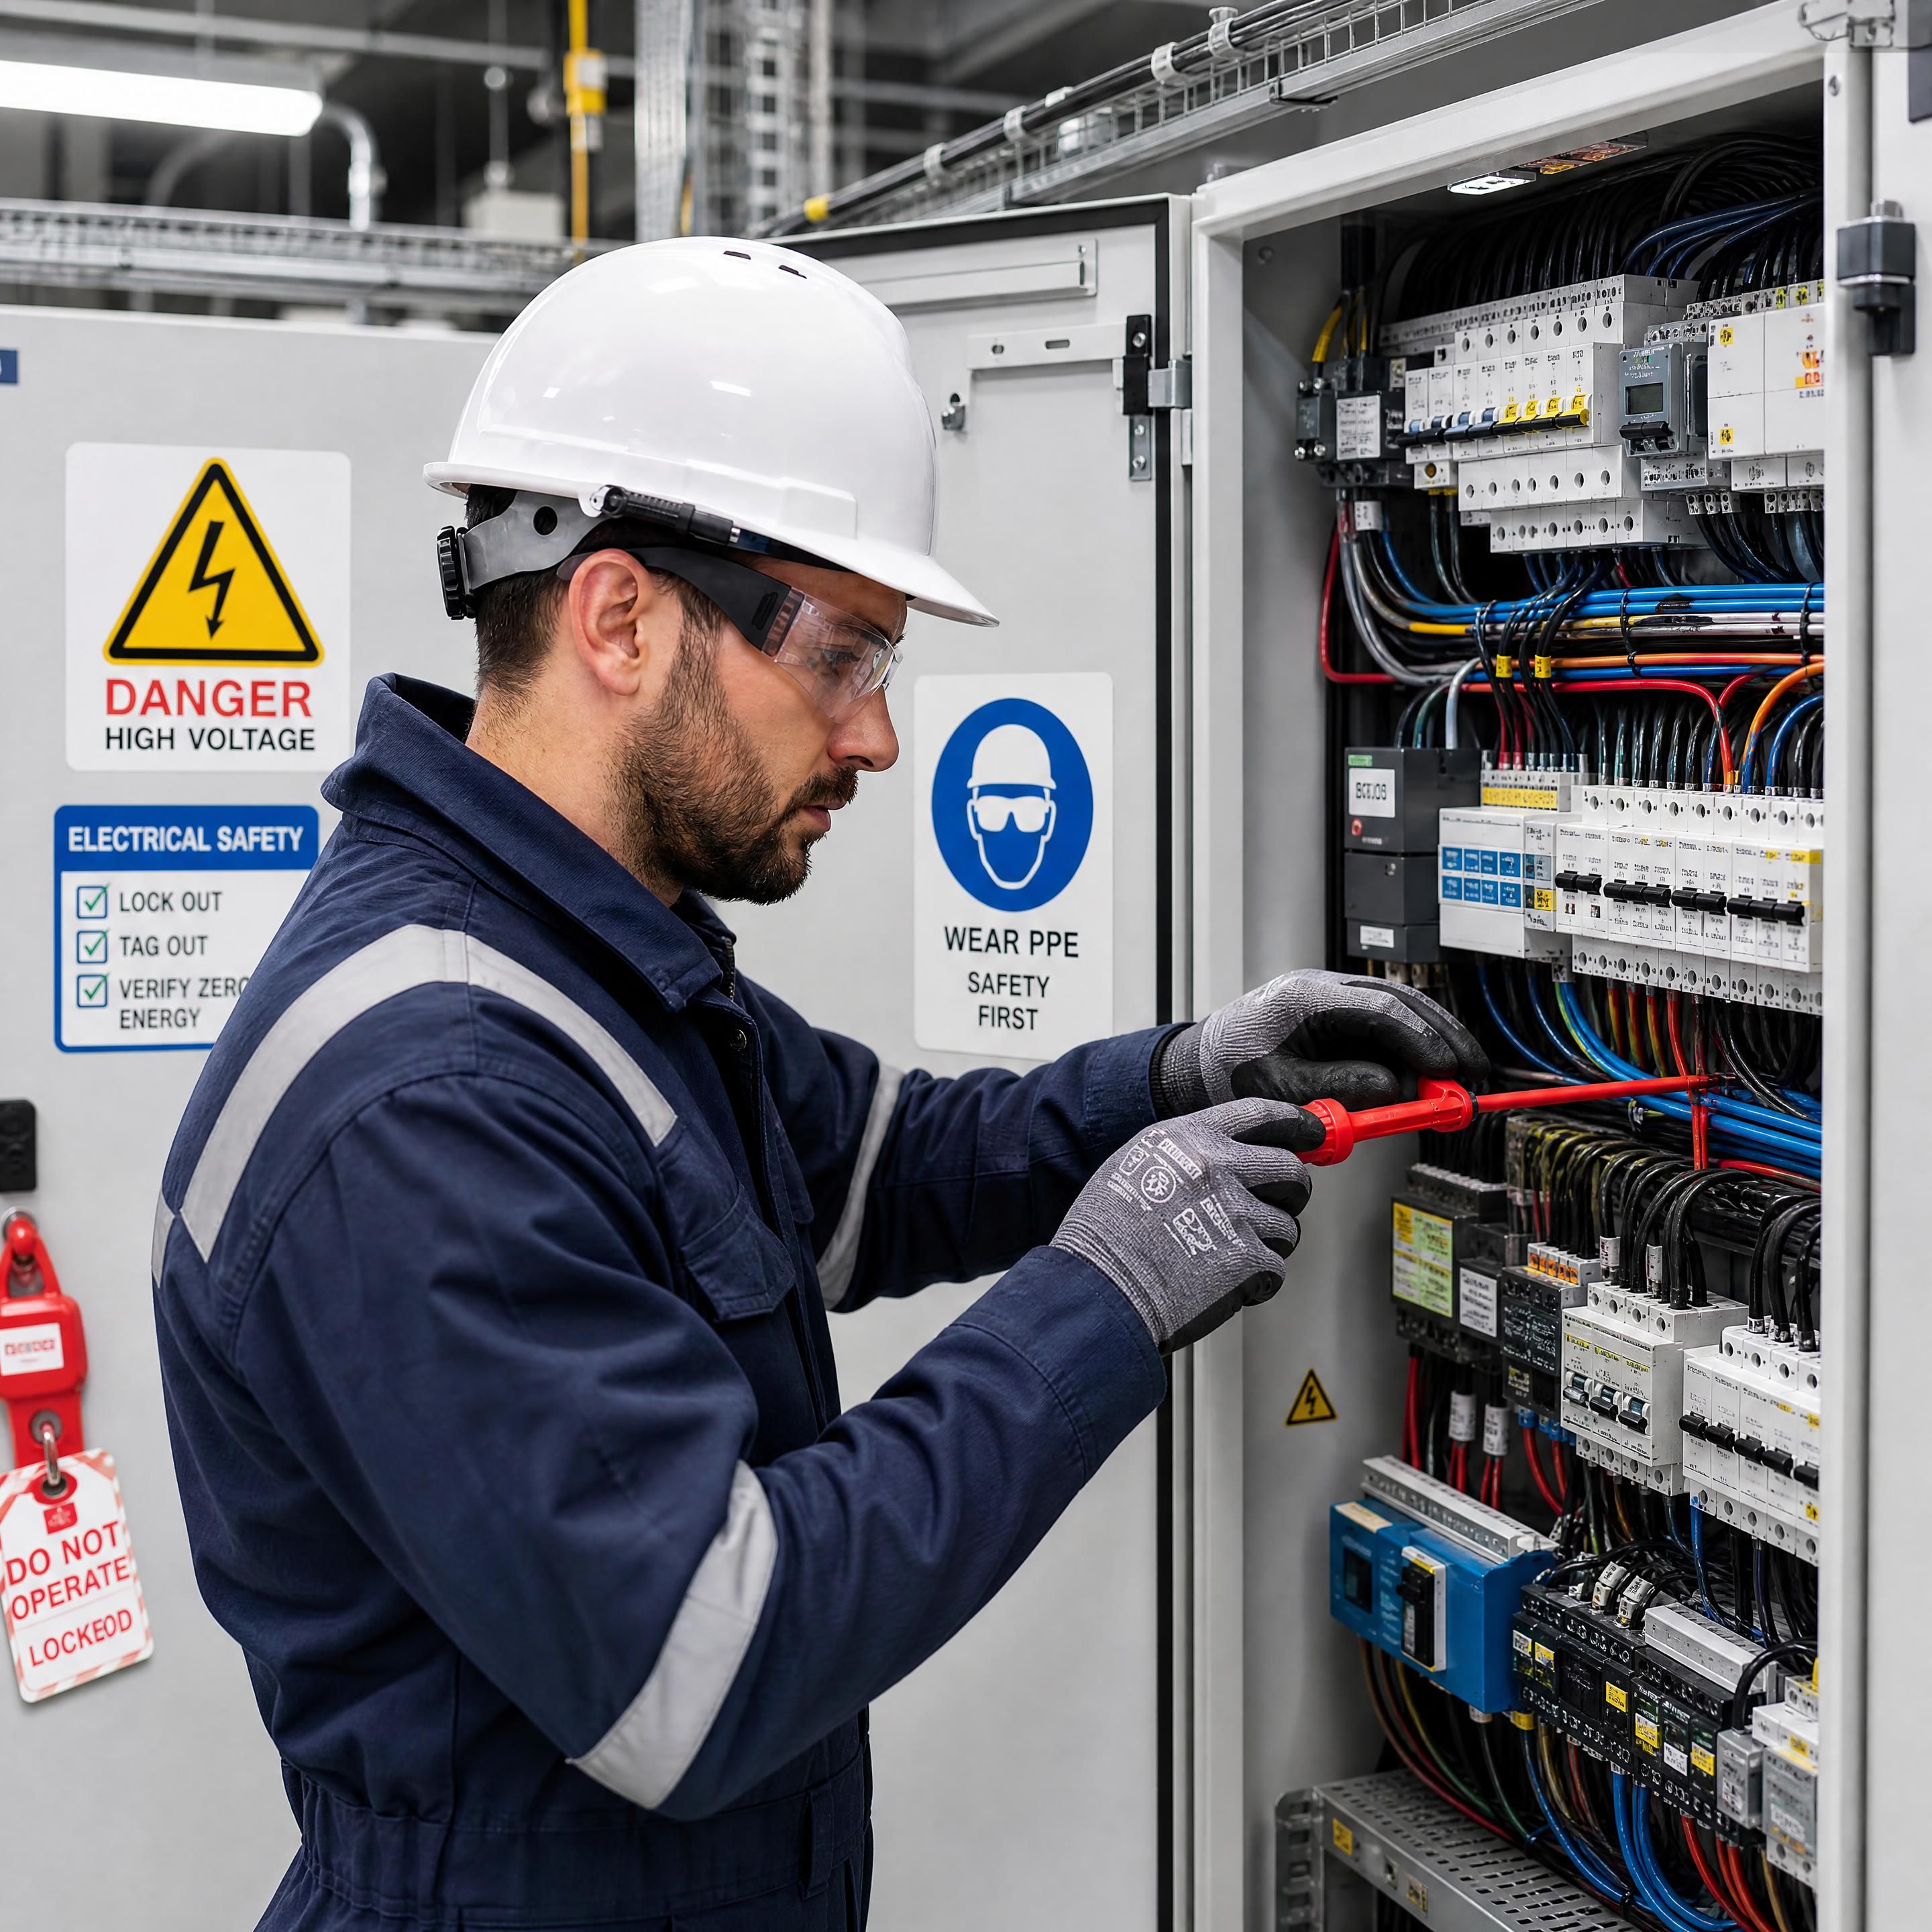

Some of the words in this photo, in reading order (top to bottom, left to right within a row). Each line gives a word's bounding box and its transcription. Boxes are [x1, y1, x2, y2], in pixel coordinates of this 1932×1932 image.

[107, 679, 312, 718] DANGER
[106, 727, 174, 750] HIGH
[189, 728, 315, 751] VOLTAGE
[68, 826, 212, 852] ELECTRICAL
[217, 826, 303, 852] SAFETY
[120, 892, 174, 912] LOCK
[182, 892, 223, 912] OUT
[119, 936, 159, 956] TAG
[167, 936, 208, 956] OUT
[945, 926, 1019, 955] WEAR
[1030, 930, 1079, 958] PPE
[119, 979, 191, 999] VERIFY
[968, 971, 1050, 998] SAFETY
[120, 1008, 200, 1029] ENERGY
[979, 1005, 1038, 1030] FIRST
[6, 1548, 50, 1586] DO
[61, 1521, 118, 1564] NOT
[12, 1556, 129, 1620] OPERATE
